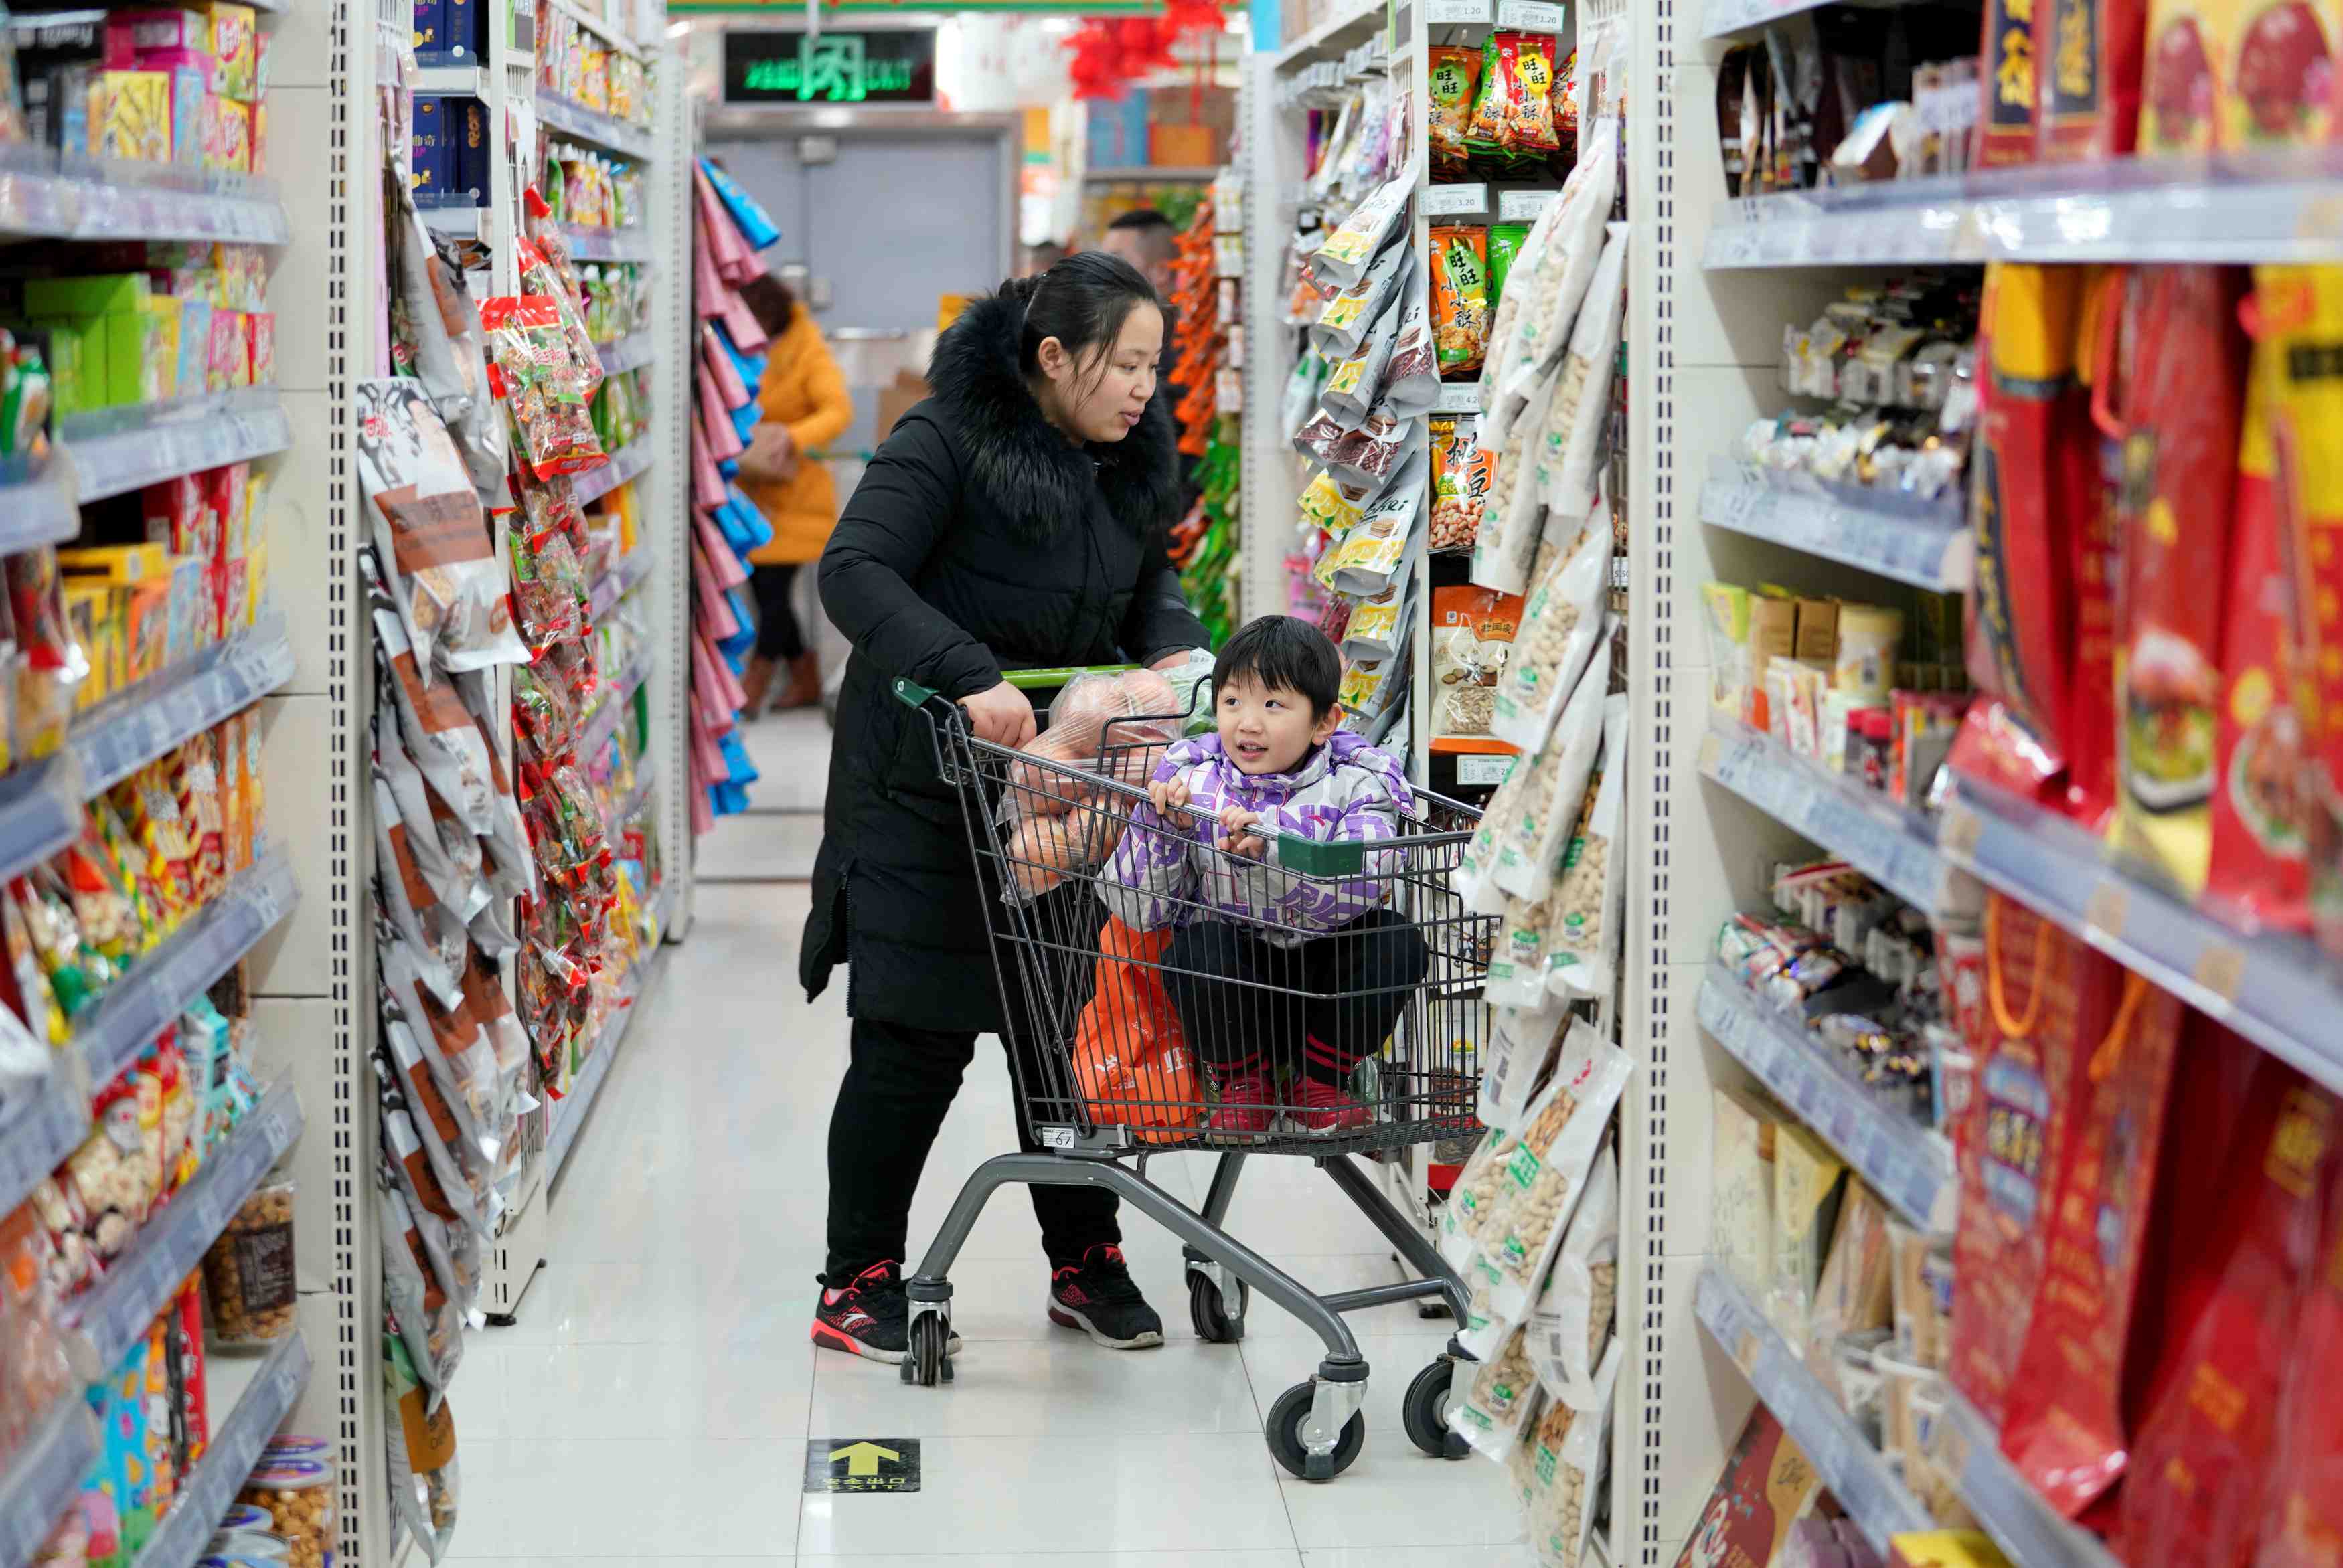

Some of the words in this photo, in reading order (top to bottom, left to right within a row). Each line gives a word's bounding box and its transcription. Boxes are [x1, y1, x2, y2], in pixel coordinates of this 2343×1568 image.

[1540, 15, 1557, 24] 1.20
[1436, 69, 1459, 94] 旺旺
[1522, 58, 1548, 85] 旺旺
[1457, 199, 1475, 207] 3.20
[1449, 250, 1481, 286] 旺旺
[1441, 276, 1477, 328] 小小酥
[1056, 1131, 1072, 1146] 67
